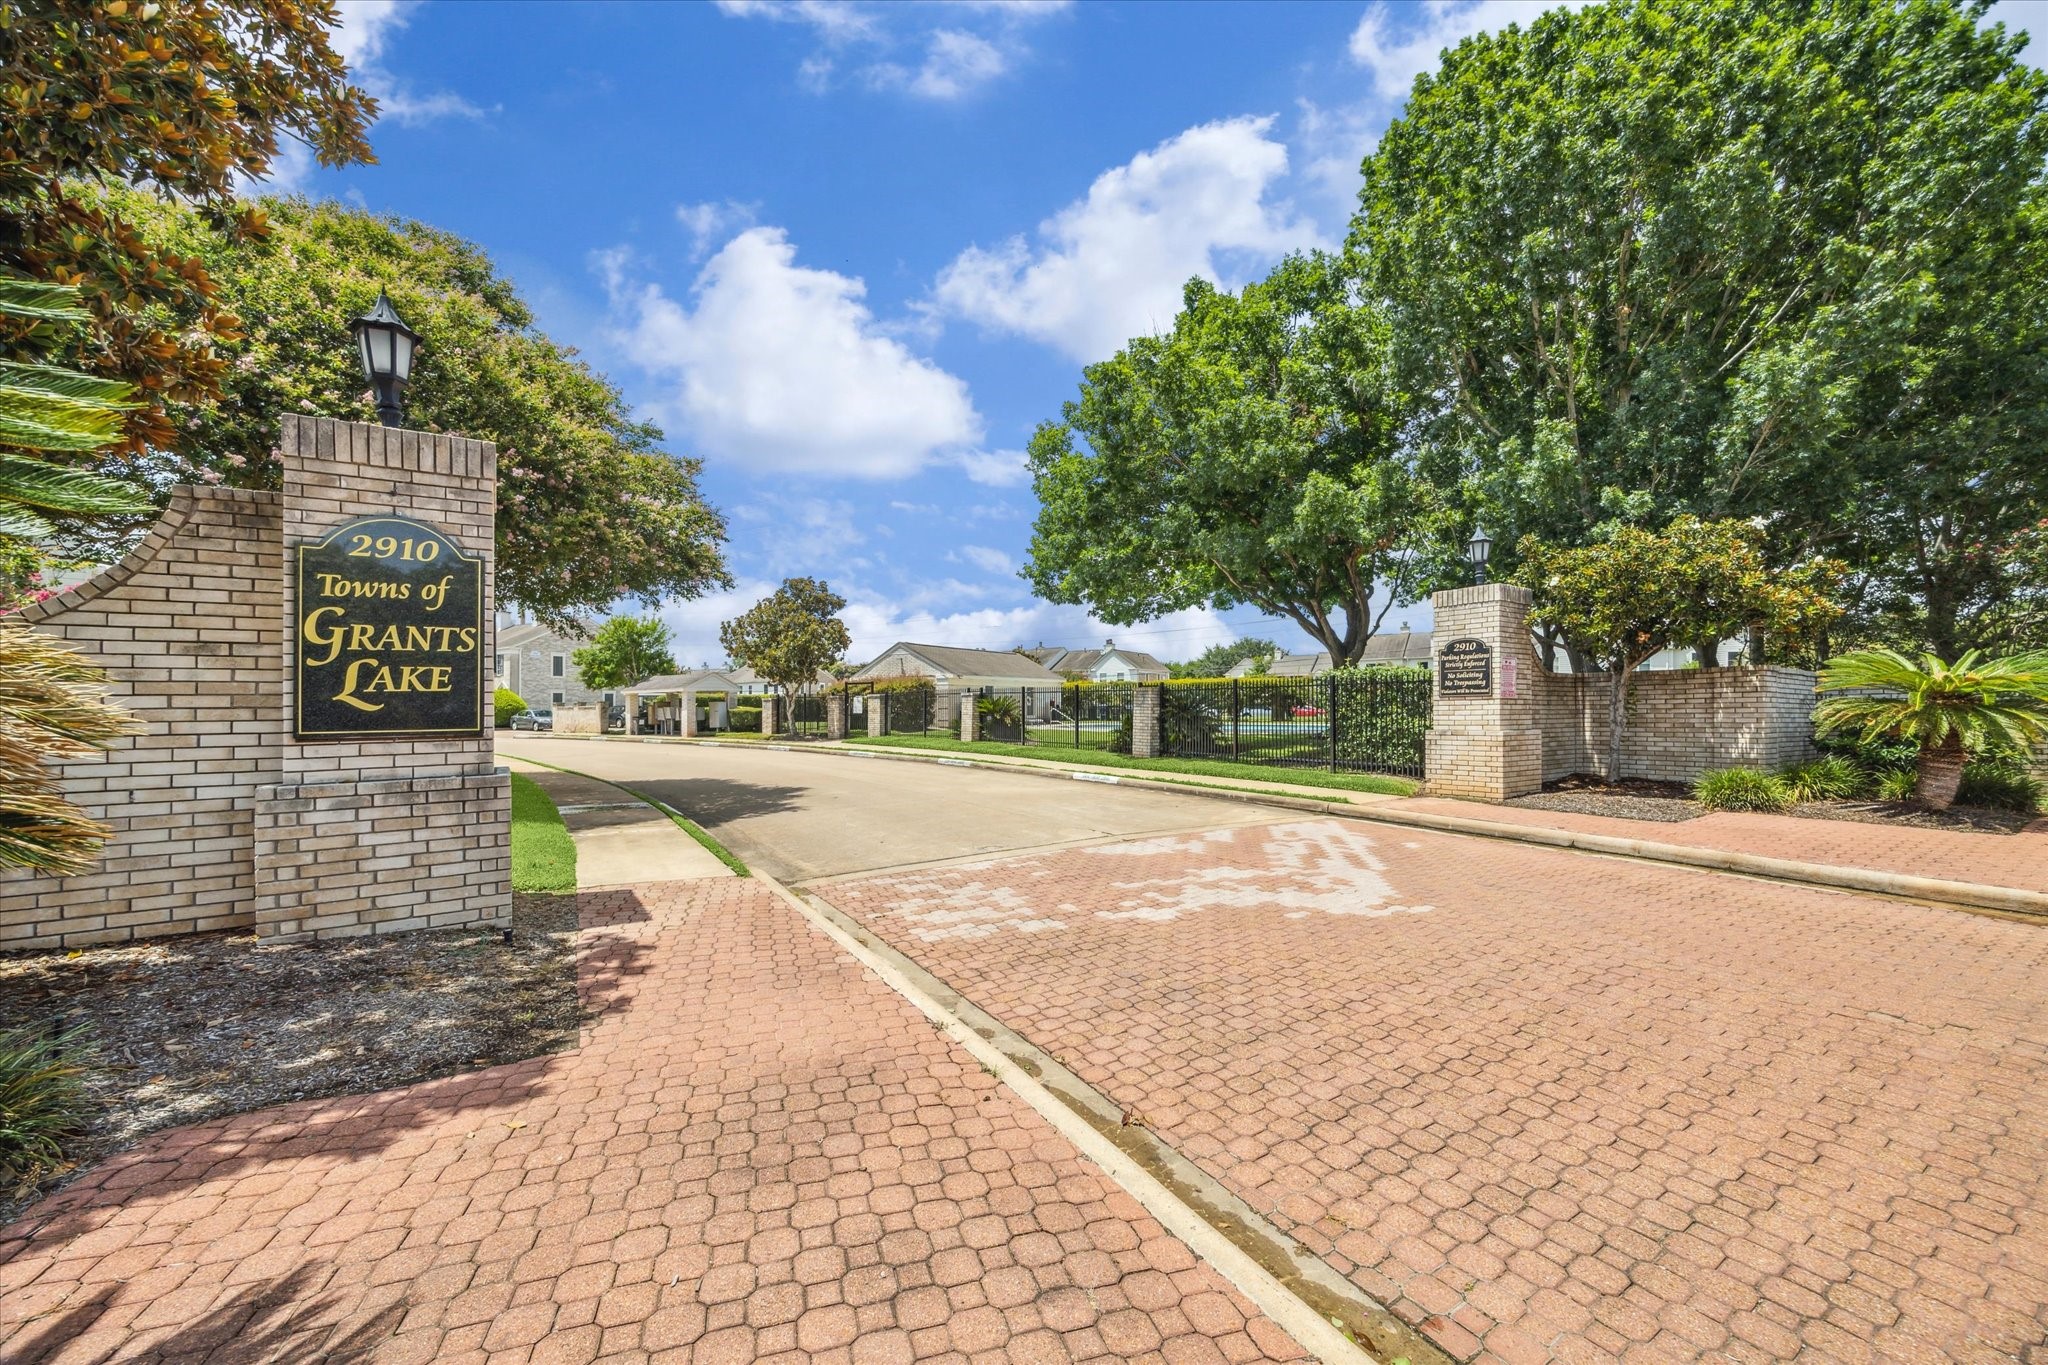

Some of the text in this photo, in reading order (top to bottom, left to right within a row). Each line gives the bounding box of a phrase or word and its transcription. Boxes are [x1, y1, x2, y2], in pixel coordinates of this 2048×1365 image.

[348, 534, 440, 562] 2910
[316, 573, 454, 611] Towns of
[303, 606, 477, 667] GRANTS
[1454, 642, 1476, 651] 2910
[1442, 652, 1490, 662] Parking Regulations
[1445, 659, 1486, 669] Strictly Enforced
[332, 658, 453, 712] LAKE
